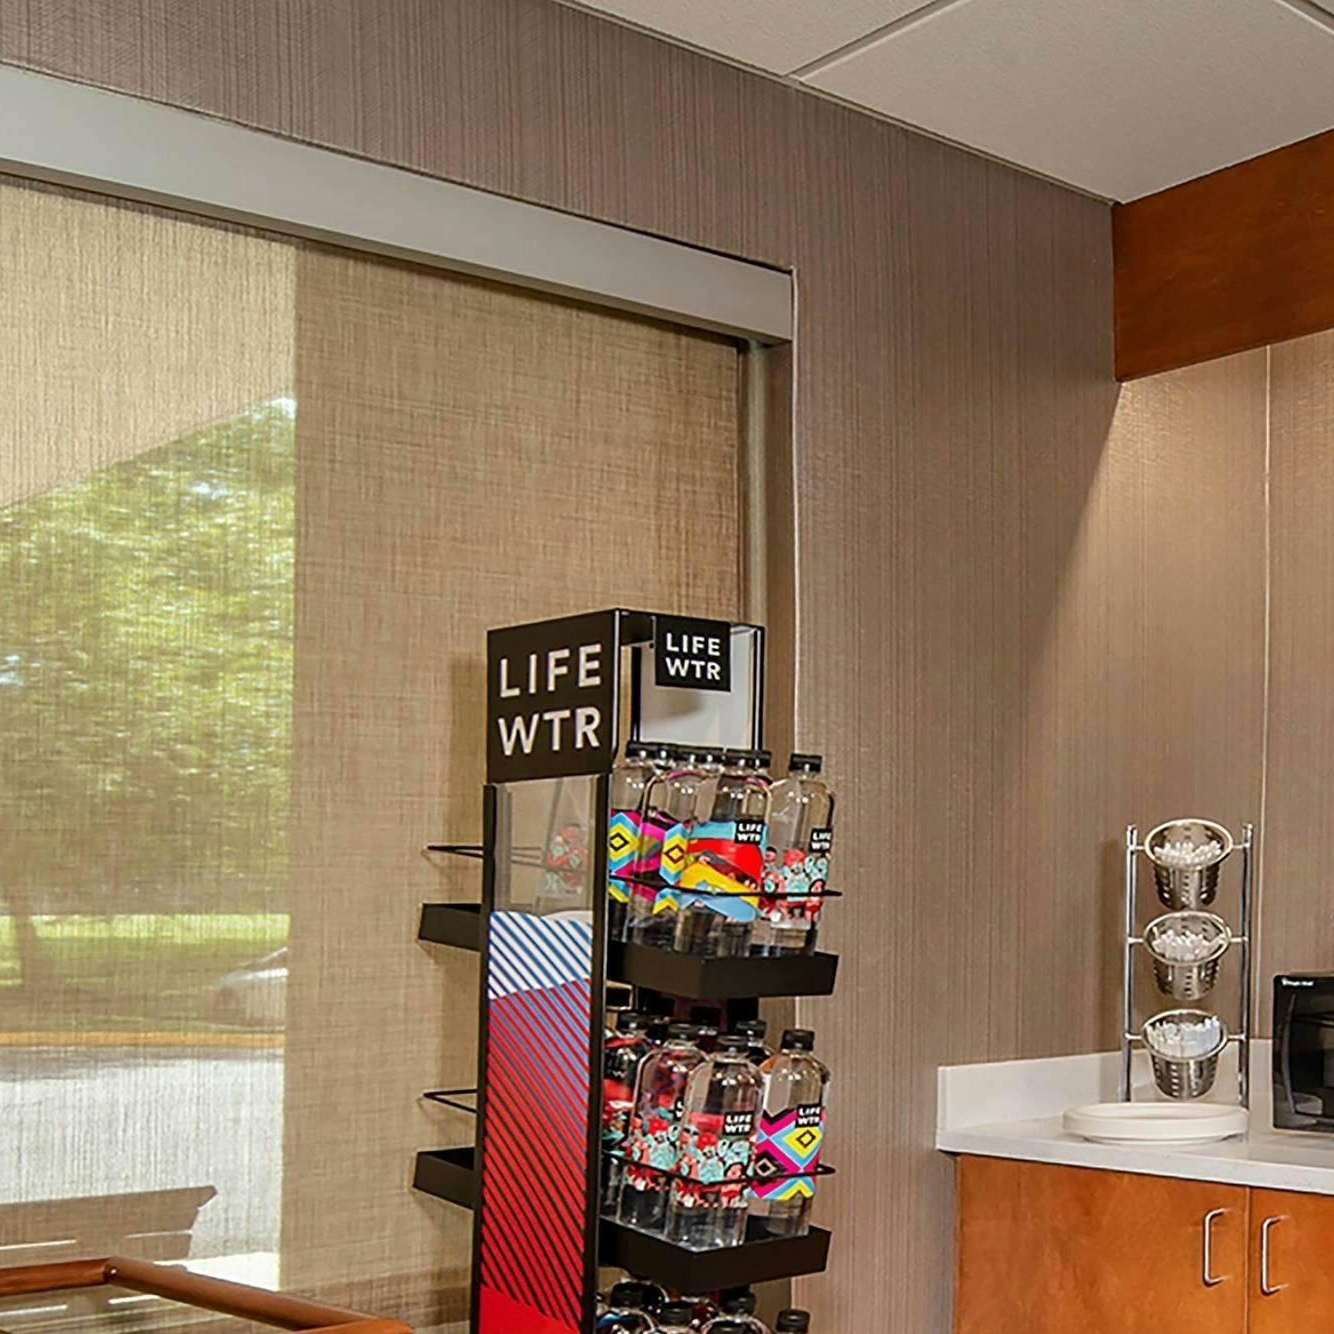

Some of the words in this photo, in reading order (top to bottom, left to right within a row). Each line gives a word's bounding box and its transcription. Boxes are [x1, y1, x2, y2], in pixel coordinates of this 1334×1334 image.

[666, 632, 721, 656] LIFE
[499, 643, 603, 698] LIFE
[666, 657, 722, 681] WTR
[497, 706, 602, 757] WTR
[738, 823, 763, 832] LIFE
[726, 1114, 752, 1124] LIFE
[798, 1106, 820, 1116] LIFE
